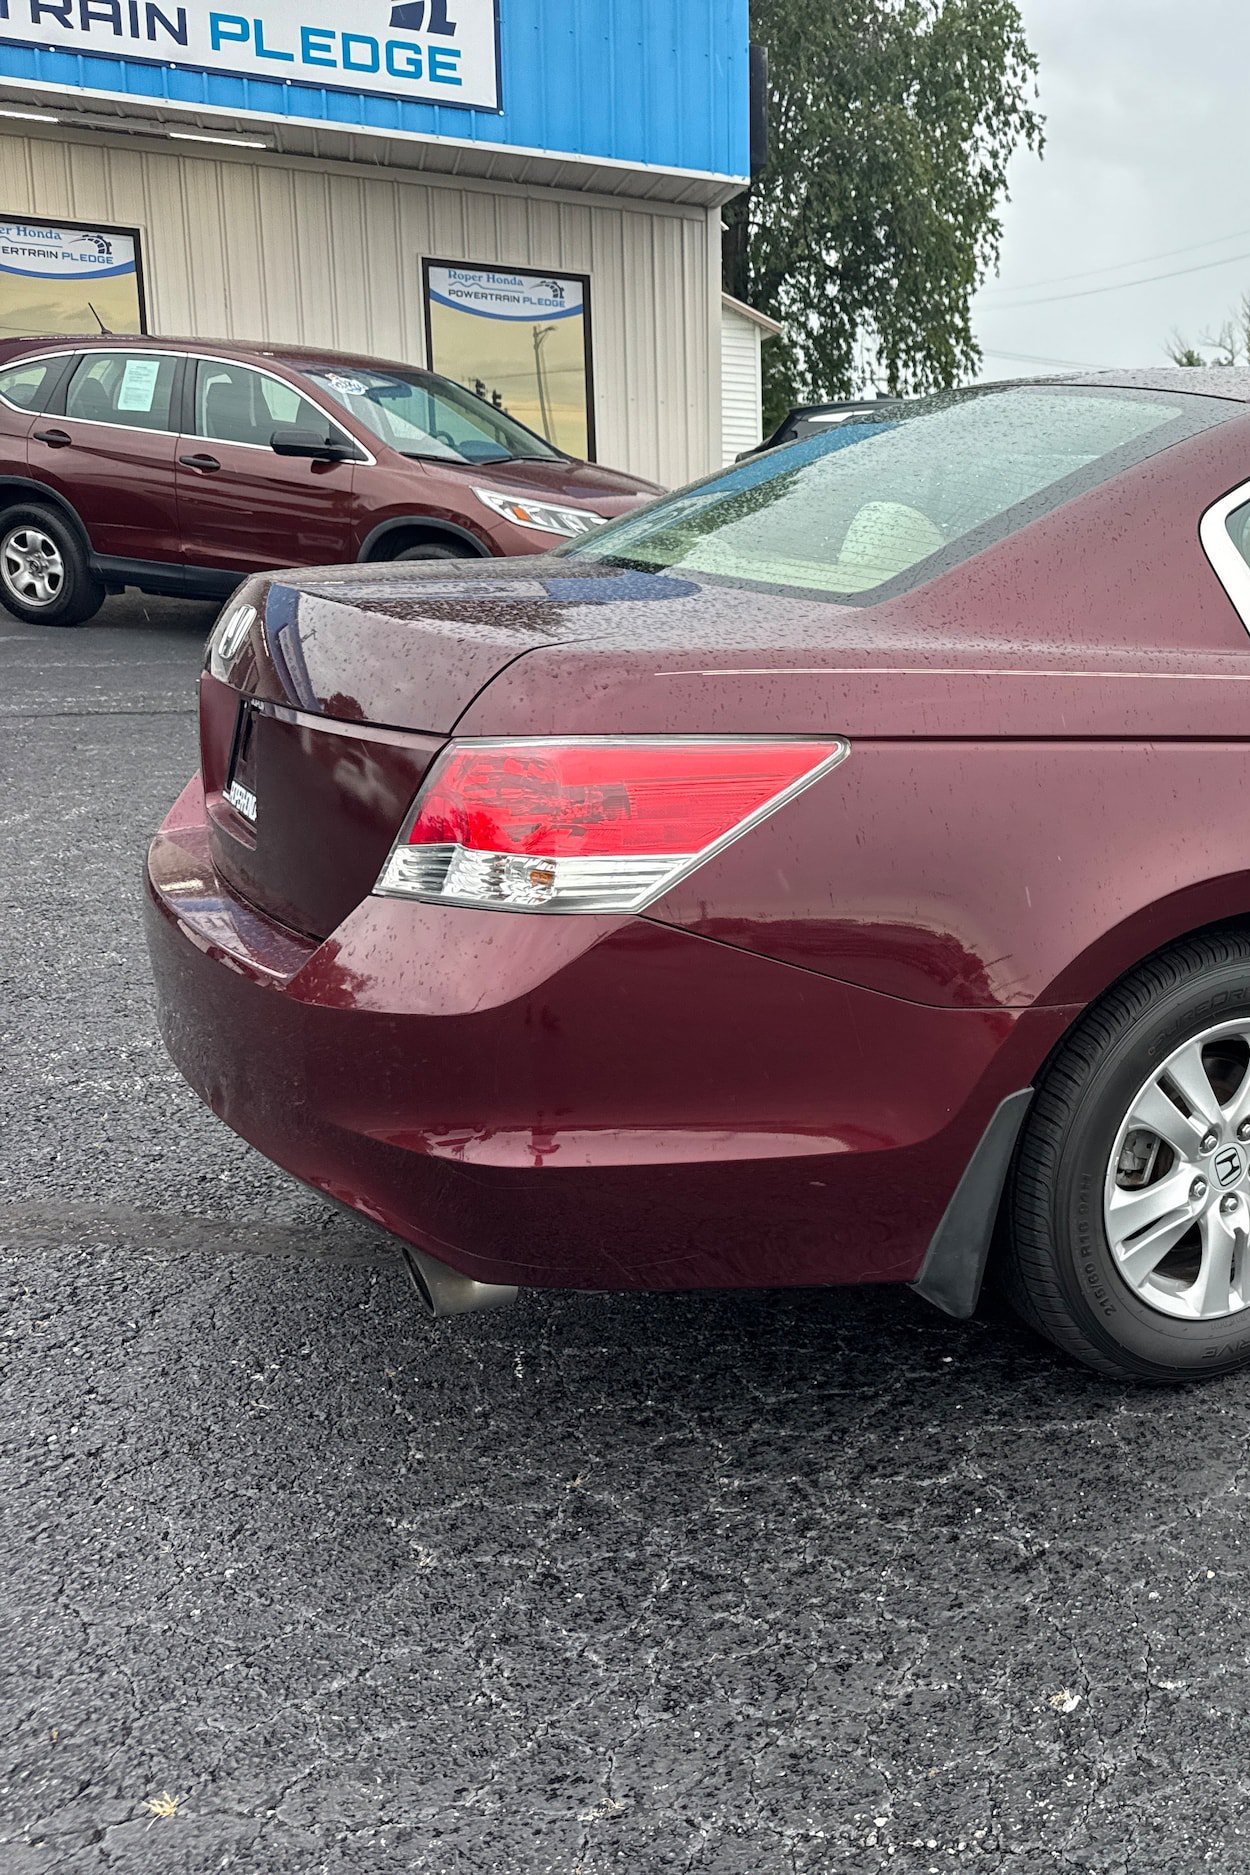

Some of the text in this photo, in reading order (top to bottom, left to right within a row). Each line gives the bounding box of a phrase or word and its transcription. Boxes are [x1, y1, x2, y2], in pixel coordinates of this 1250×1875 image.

[209, 12, 462, 86] PLEDGE
[16, 225, 62, 240] Honda
[61, 251, 114, 265] PLEDGE
[448, 269, 524, 286] Roper Honda
[448, 289, 566, 308] POWERTRAIN PLEDGE
